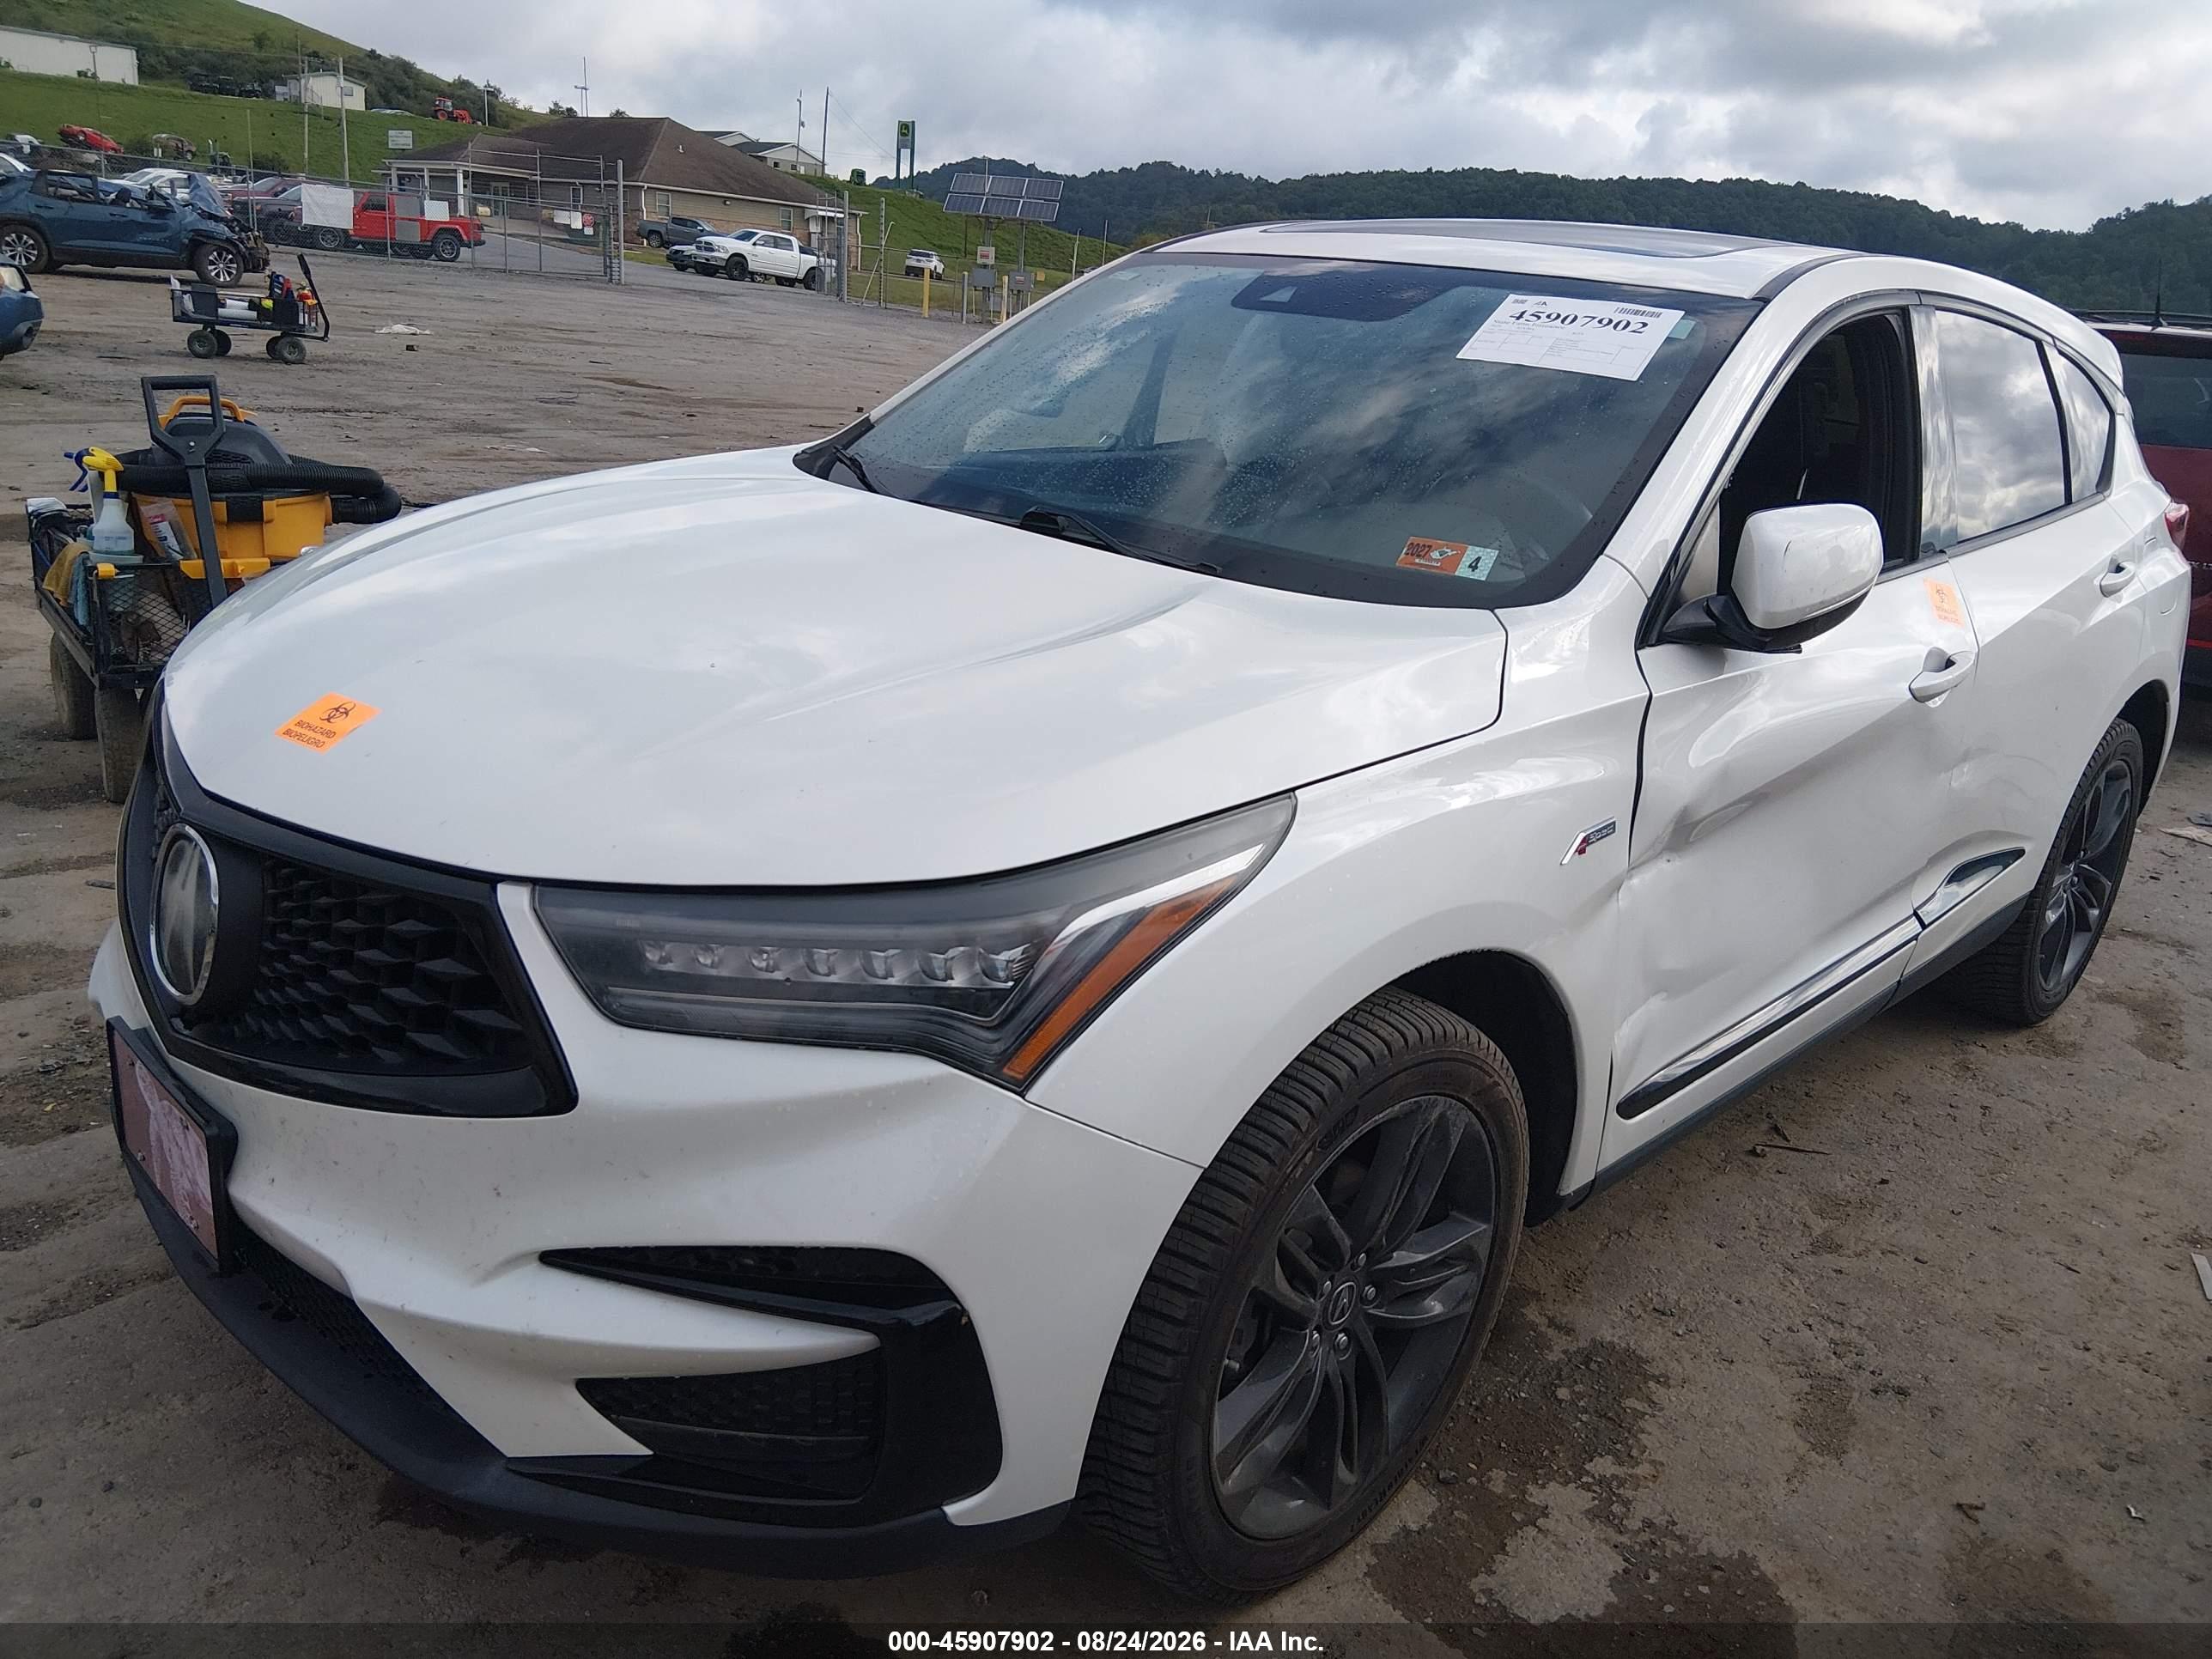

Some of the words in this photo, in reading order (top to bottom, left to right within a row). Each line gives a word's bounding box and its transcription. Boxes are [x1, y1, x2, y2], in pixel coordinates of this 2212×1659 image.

[1509, 309, 1649, 334] 45907902
[1468, 556, 1482, 572] 4
[282, 728, 325, 748] BIOPELIGRO
[295, 720, 337, 738] BIOHAZARD
